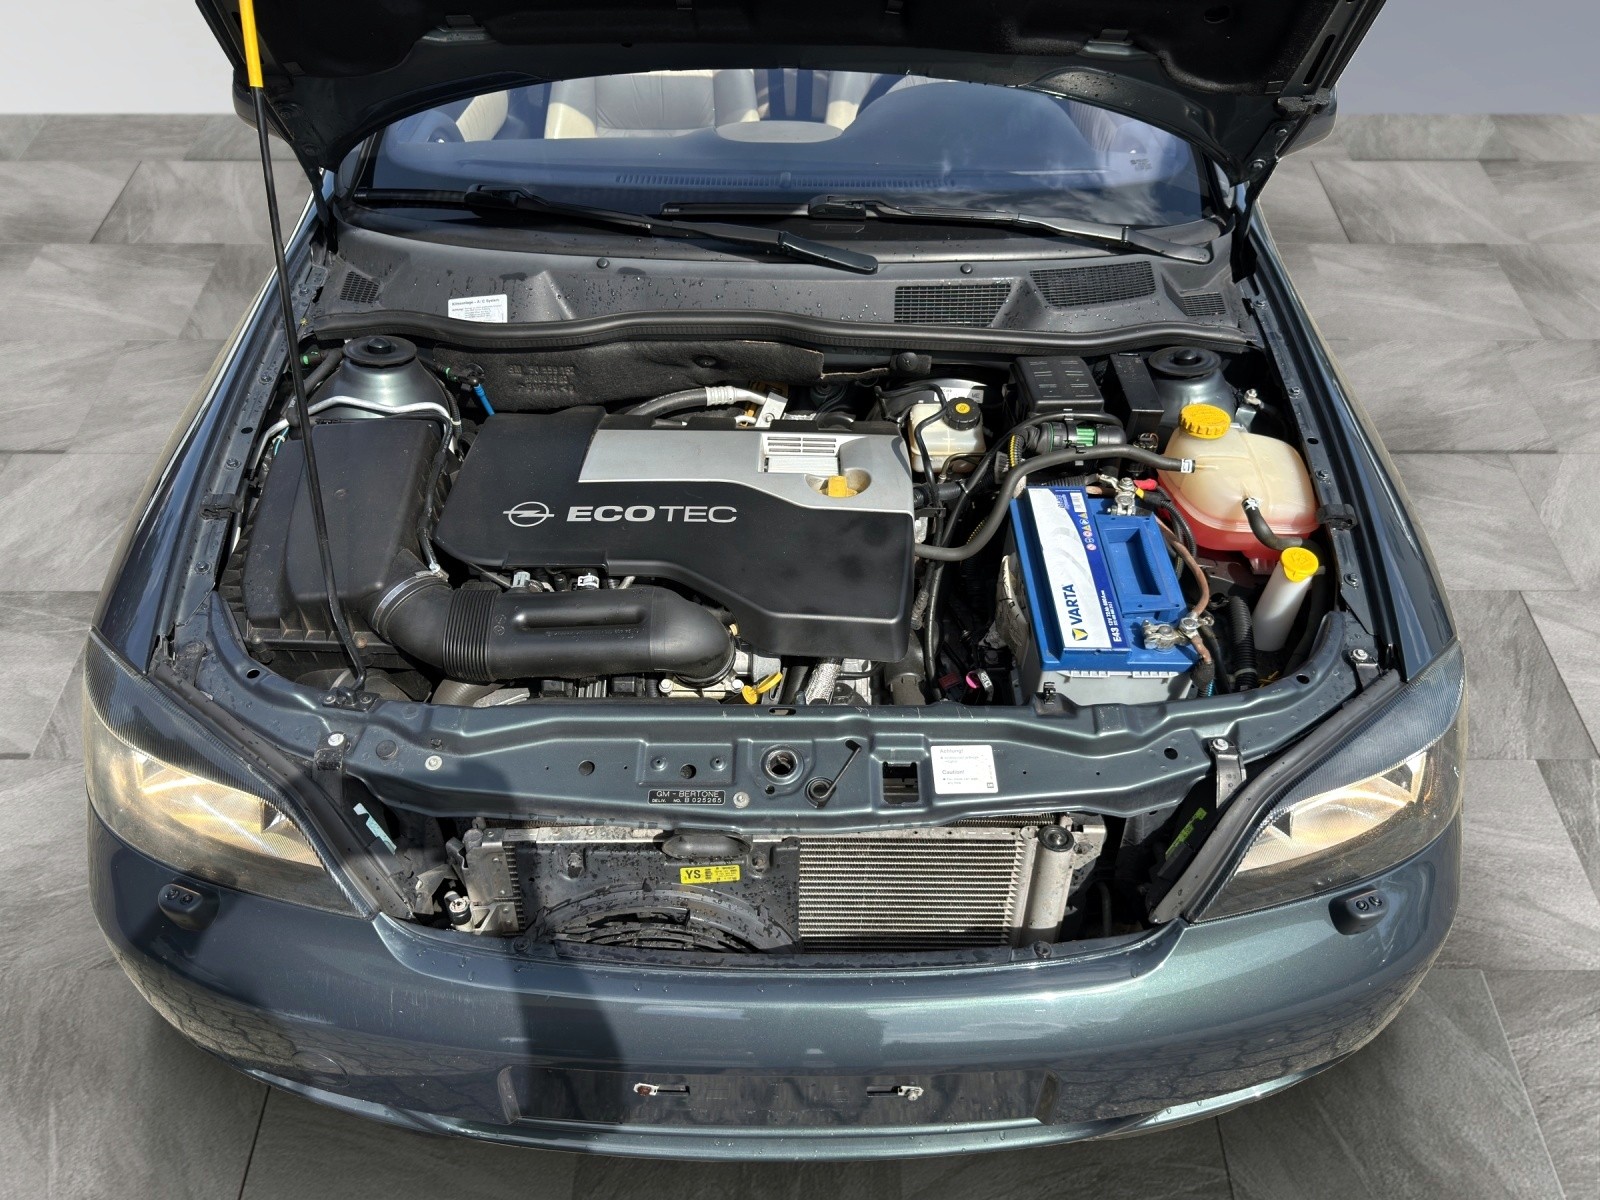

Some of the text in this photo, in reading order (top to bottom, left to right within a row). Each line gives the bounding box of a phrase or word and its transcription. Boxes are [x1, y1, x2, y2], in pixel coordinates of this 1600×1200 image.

[567, 505, 738, 523] ECOTEC
[1062, 583, 1083, 626] VARTA
[1110, 627, 1122, 642] E43
[656, 790, 670, 798] GM
[678, 790, 720, 798] BERTONE
[685, 869, 701, 879] YS
